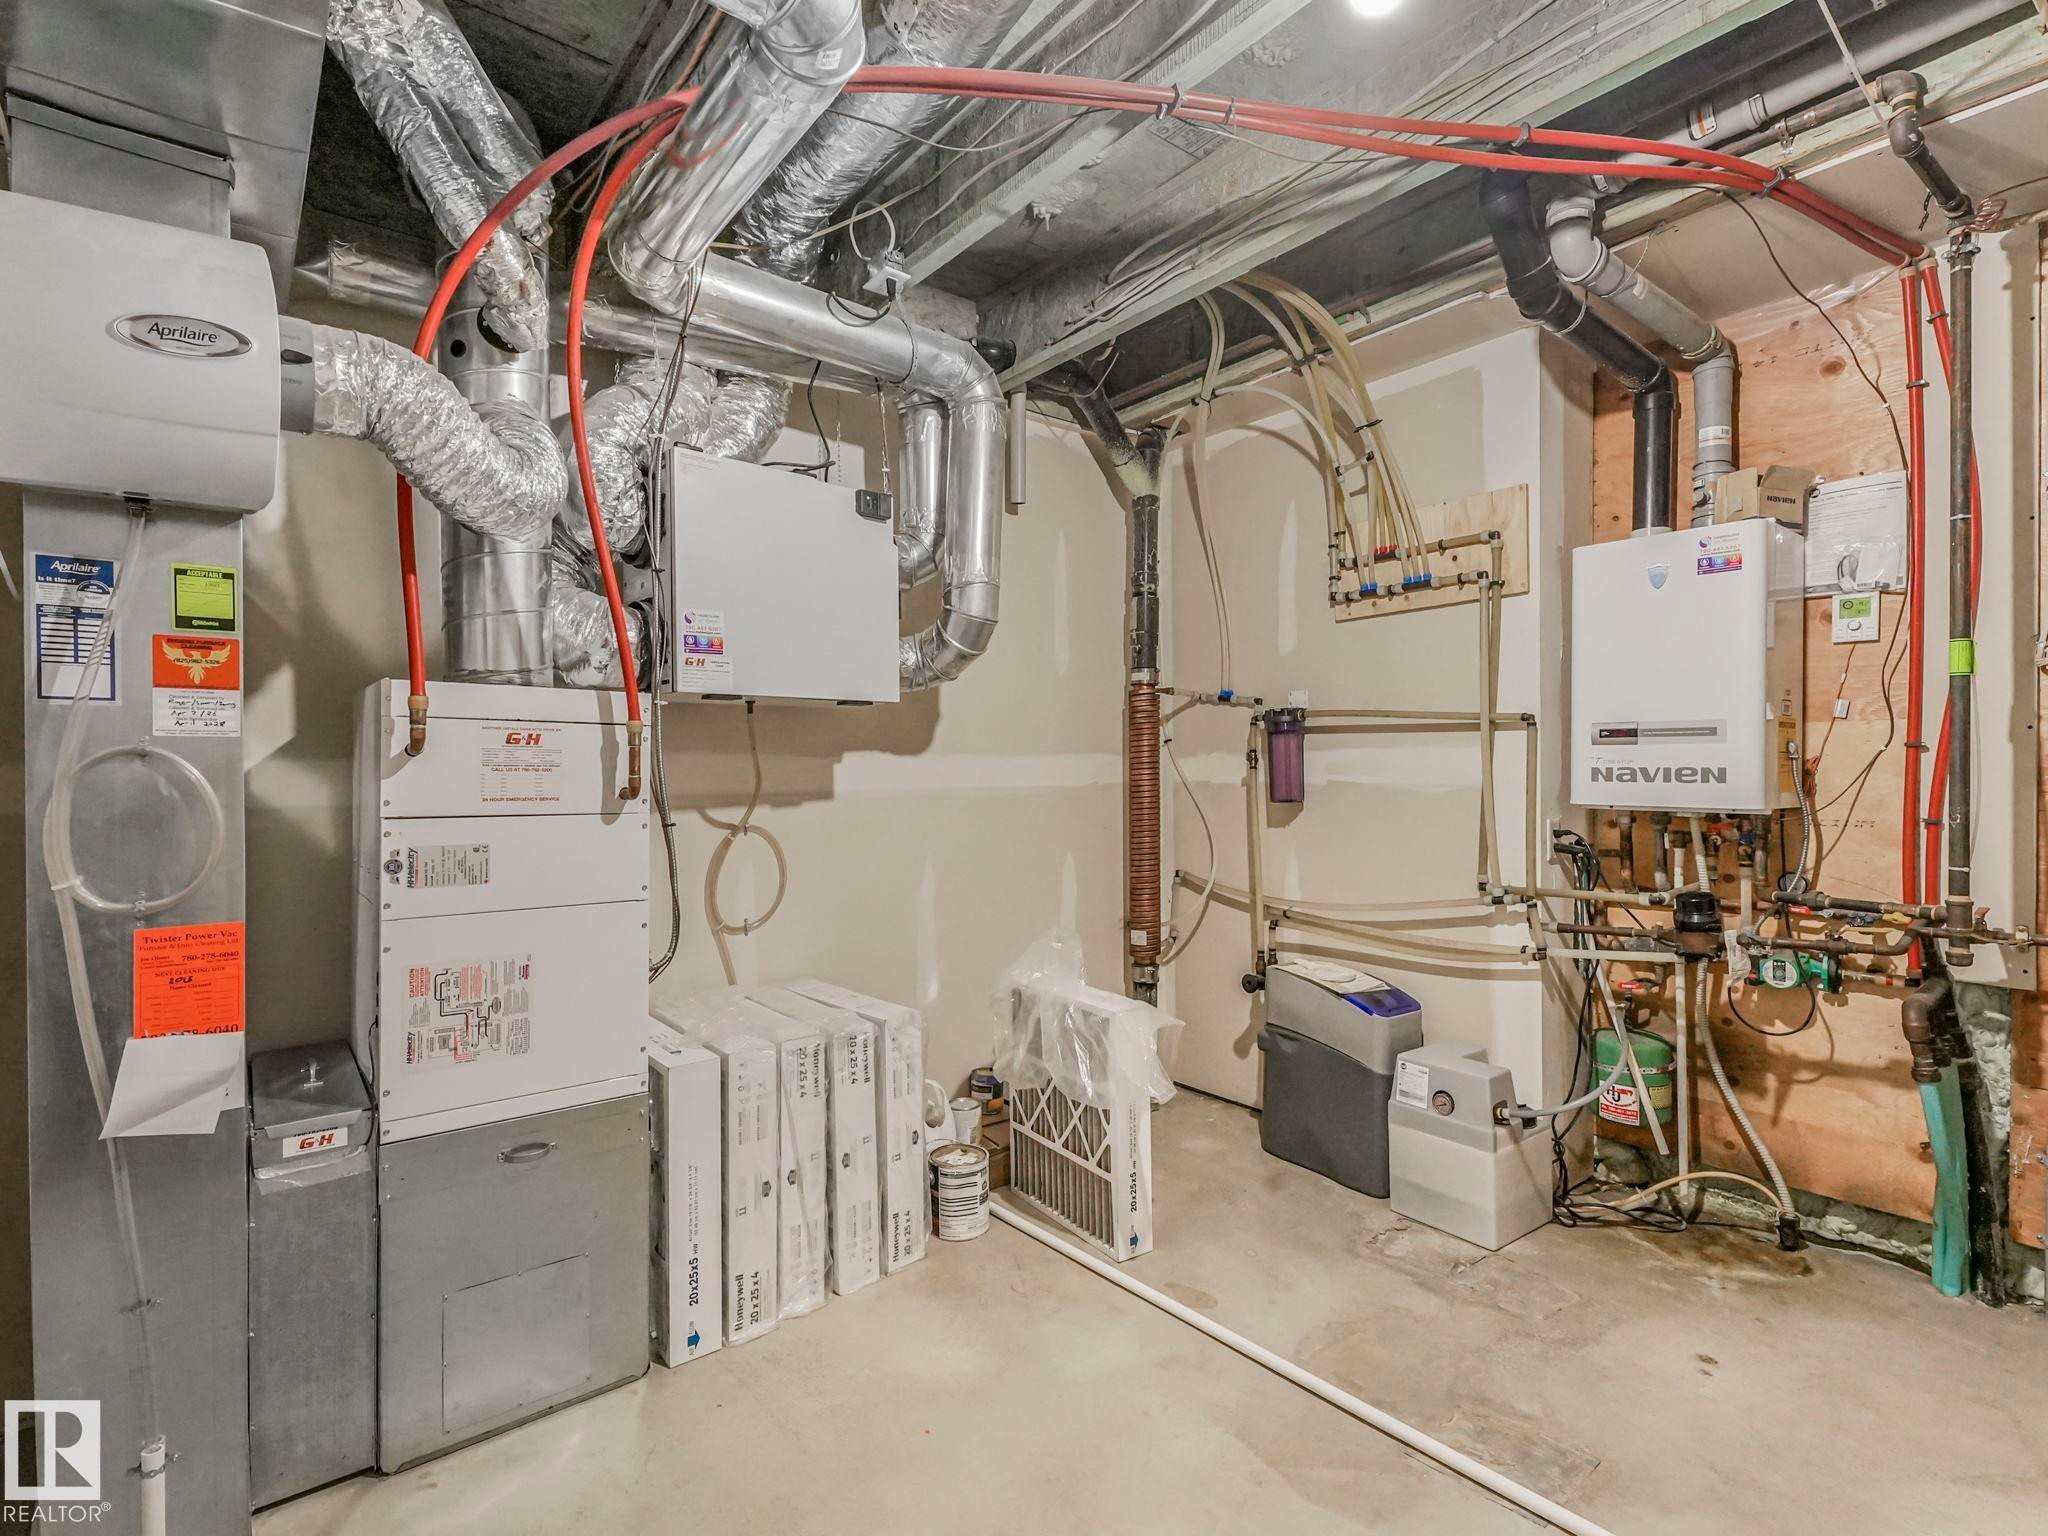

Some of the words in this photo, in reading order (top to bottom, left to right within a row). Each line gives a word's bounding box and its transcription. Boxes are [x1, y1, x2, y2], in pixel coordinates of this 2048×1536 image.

[147, 321, 219, 343] Aprilaire
[50, 560, 100, 573] Aprilaire
[186, 569, 224, 579] ACCEPTABLE
[505, 732, 542, 746] G&H
[143, 936, 182, 944] Twister
[185, 932, 217, 941] Power
[181, 950, 240, 962] 780-278-6040
[174, 967, 210, 976] CLEANING
[850, 1056, 858, 1069] 25
[799, 1069, 808, 1082] 25
[1129, 1171, 1138, 1213] 20x25x5
[892, 1212, 900, 1263] Honeywell
[903, 1225, 911, 1237] 25
[903, 1245, 911, 1257] 20
[688, 1257, 699, 1307] 20x25x5
[750, 1288, 759, 1302] 25
[733, 1274, 745, 1332] Honeywell
[750, 1310, 759, 1325] 20
